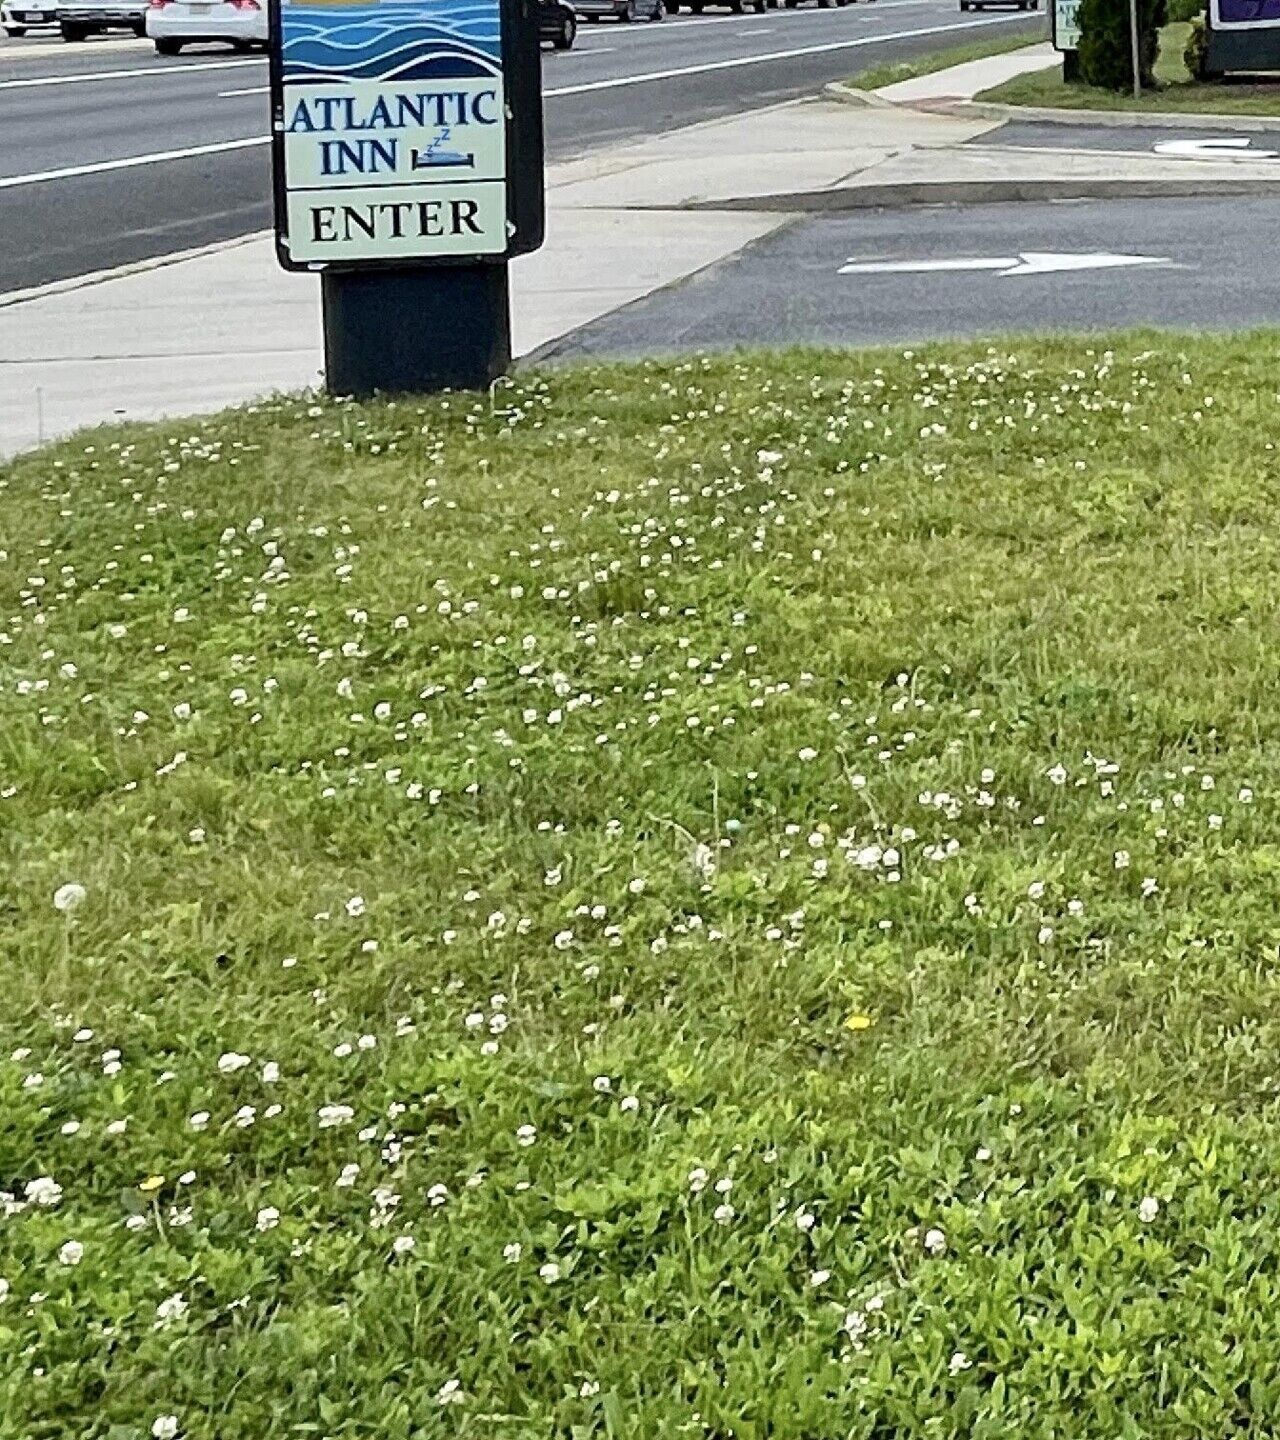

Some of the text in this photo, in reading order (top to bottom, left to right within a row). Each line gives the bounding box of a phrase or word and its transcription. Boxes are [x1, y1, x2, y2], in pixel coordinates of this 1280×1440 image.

[286, 90, 498, 132] ATLANTIC
[319, 138, 398, 175] INN
[310, 200, 485, 242] ENTER
